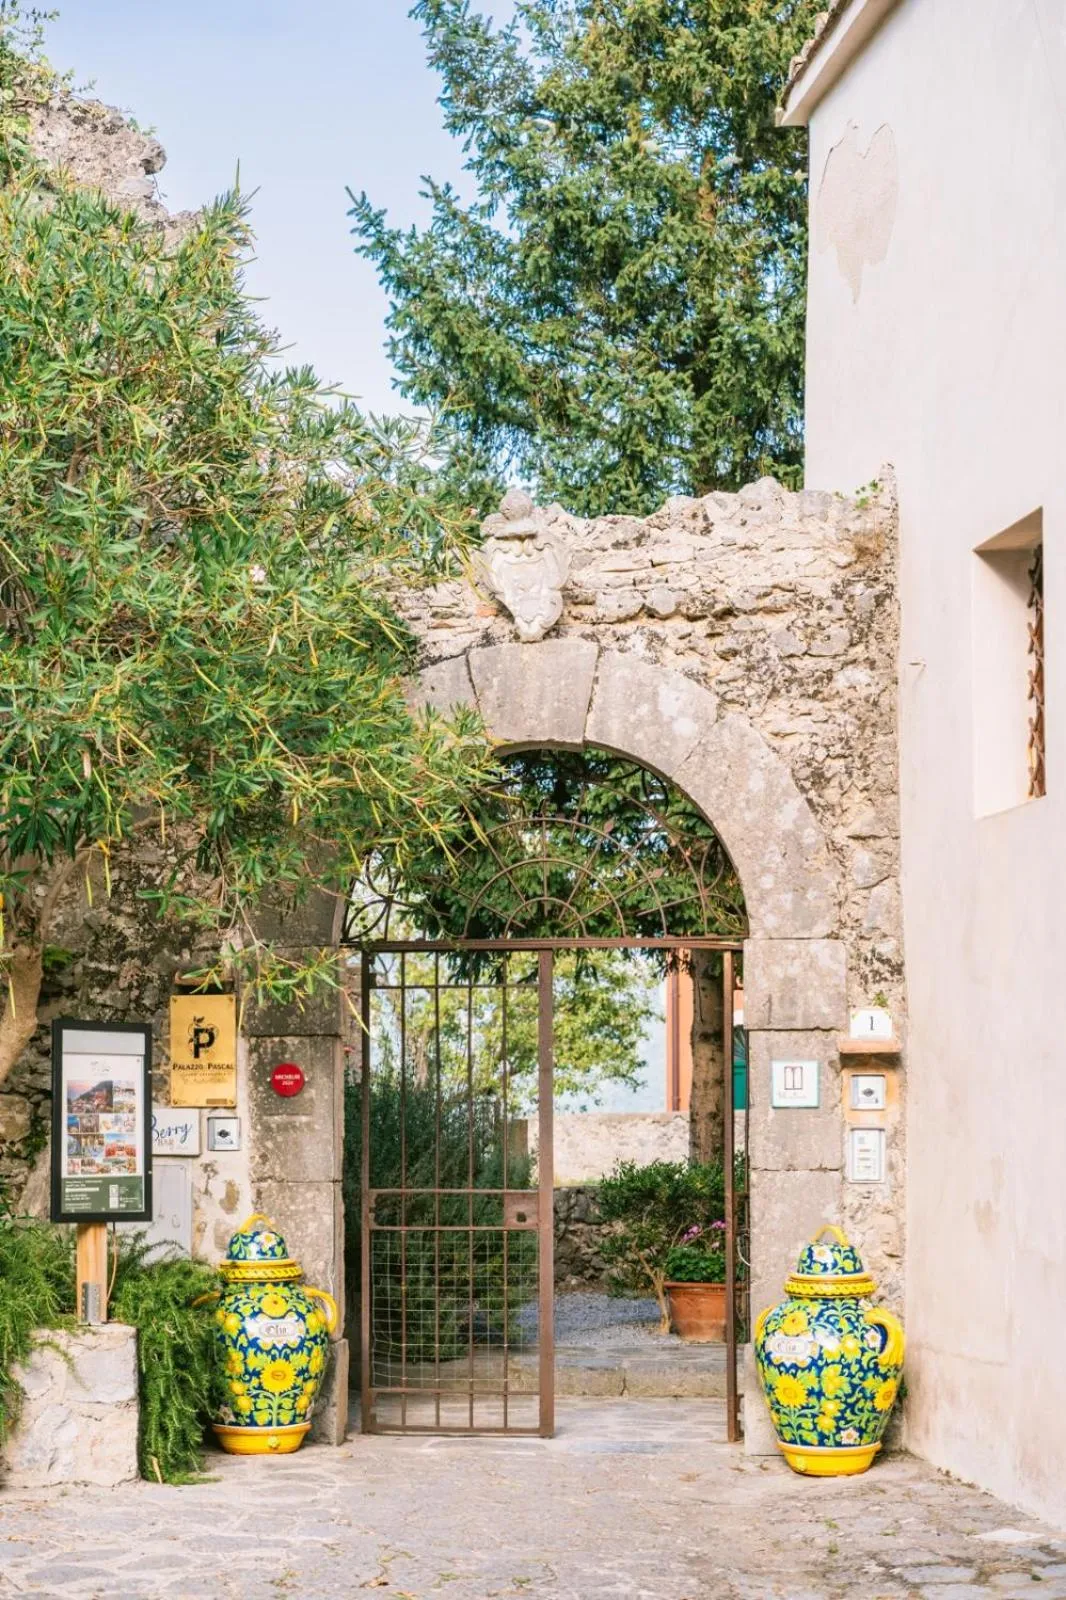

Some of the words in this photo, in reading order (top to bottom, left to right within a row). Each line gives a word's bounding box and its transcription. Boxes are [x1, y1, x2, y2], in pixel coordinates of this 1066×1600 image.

[870, 1015, 875, 1031] 1
[193, 1027, 217, 1059] P
[172, 1063, 204, 1071] PALAZZO
[207, 1063, 234, 1071] PASCAL
